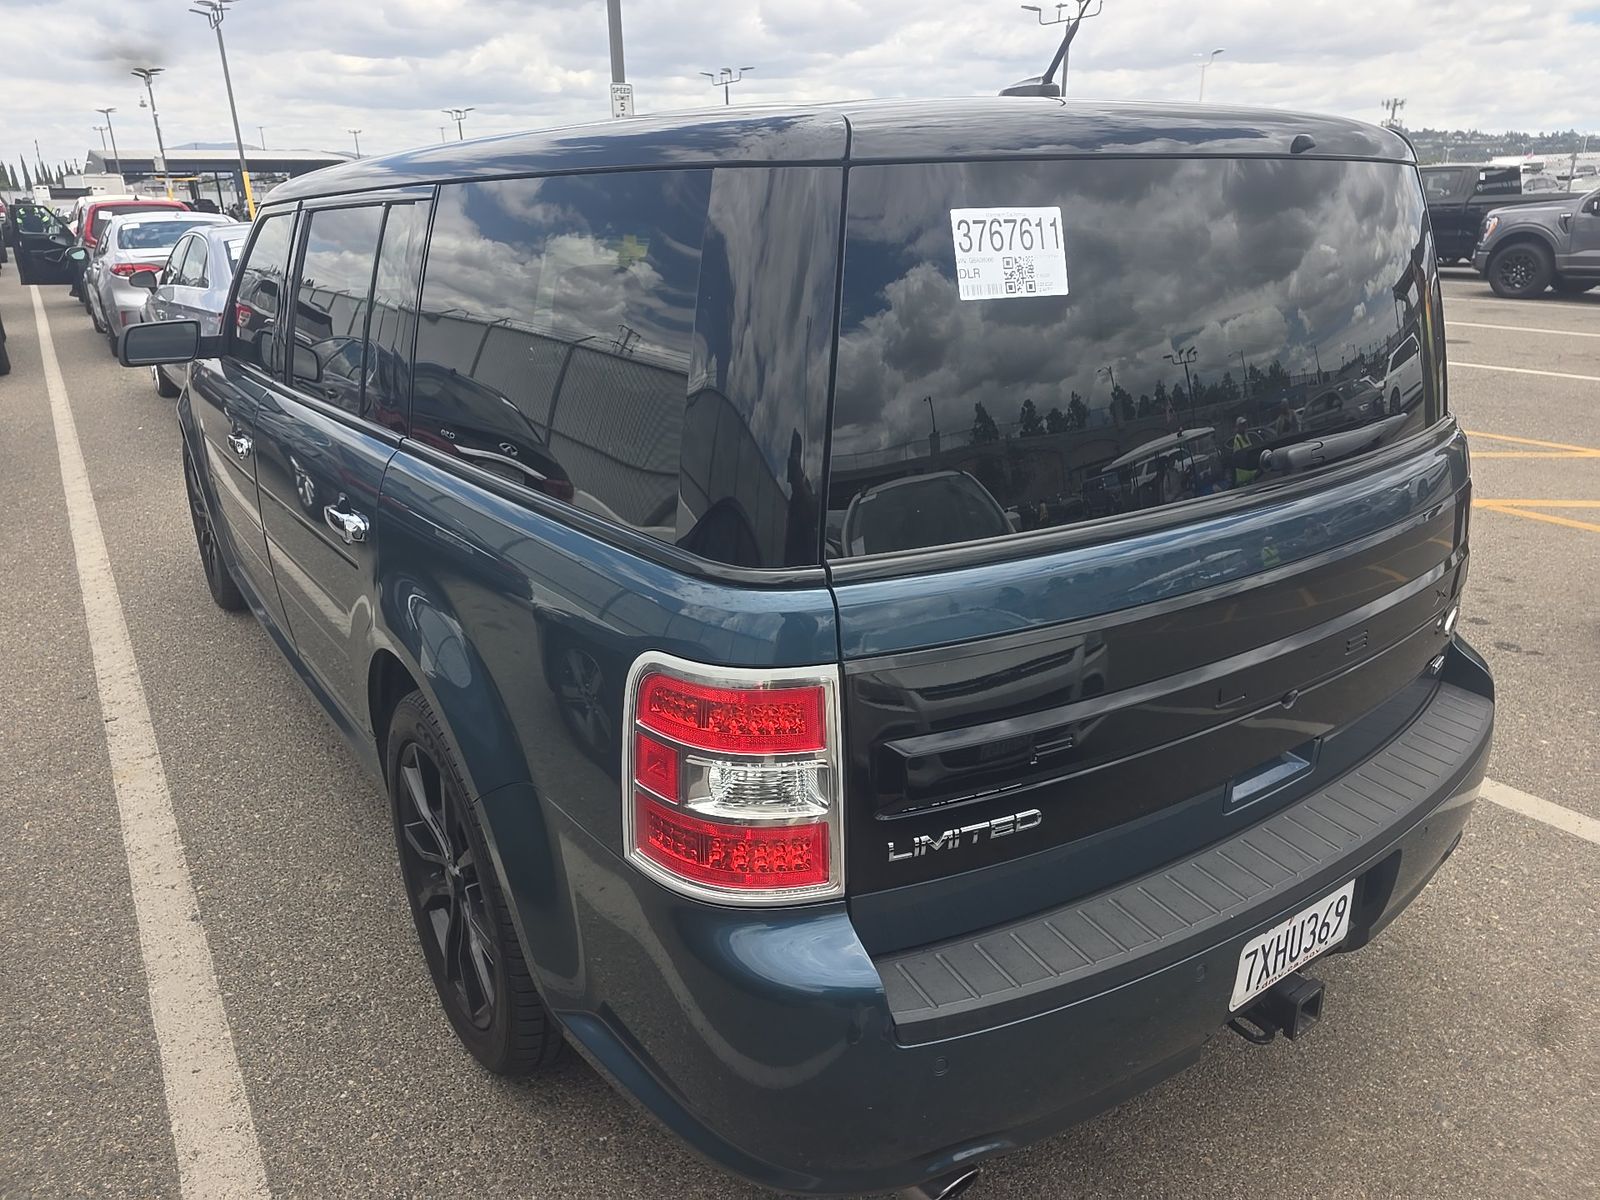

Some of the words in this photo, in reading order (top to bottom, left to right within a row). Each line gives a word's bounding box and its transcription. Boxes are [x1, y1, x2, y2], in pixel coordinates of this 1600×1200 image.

[620, 102, 626, 112] 5
[957, 217, 1060, 253] 3767611
[959, 268, 981, 279] DLR
[888, 808, 1042, 862] LIMITED
[1245, 894, 1348, 992] 7XHU369
